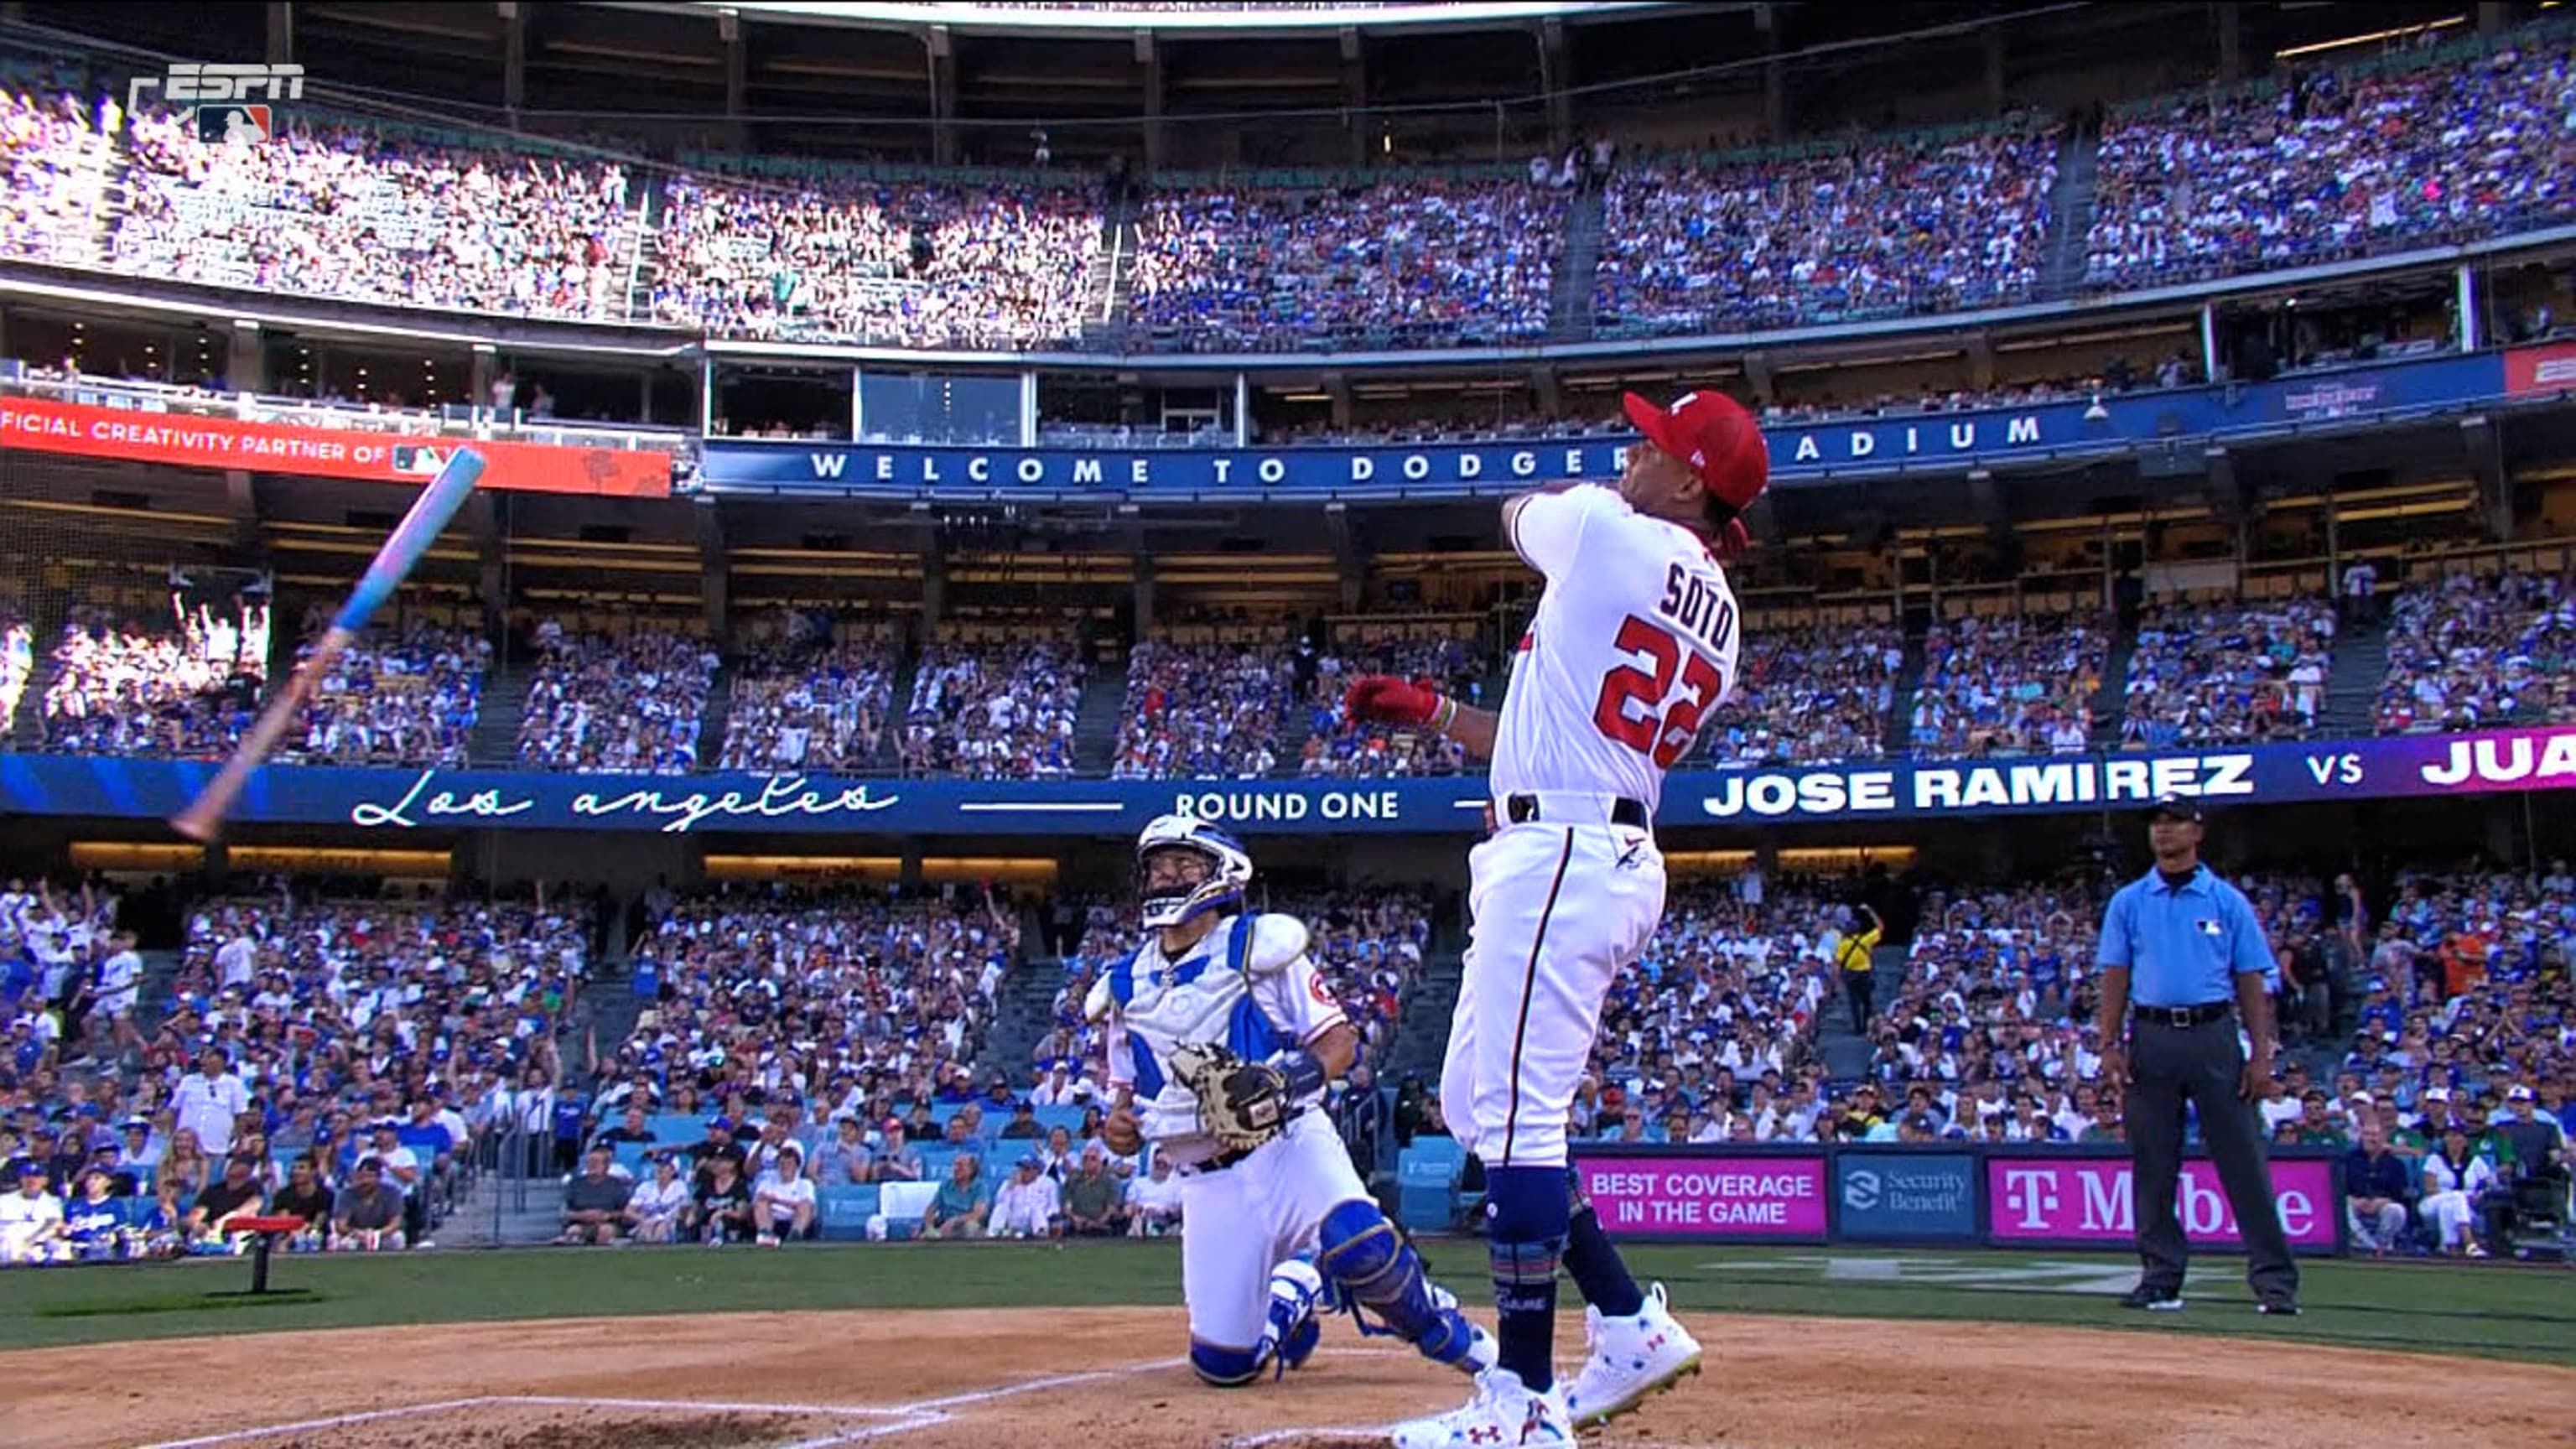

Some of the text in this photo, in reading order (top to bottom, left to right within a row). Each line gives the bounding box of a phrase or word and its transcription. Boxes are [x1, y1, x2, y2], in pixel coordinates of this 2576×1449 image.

[91, 421, 234, 451] CREATIVITY
[242, 435, 345, 460] PARTNER
[354, 445, 385, 463] OF
[812, 454, 1148, 483] WELCOME
[1213, 458, 1285, 483] TO
[1795, 417, 2040, 462] ADIUM
[1660, 563, 1733, 652] SOTO
[1594, 613, 1722, 770] 22
[352, 770, 533, 826] Los
[1176, 792, 1398, 820] ROUND ONE
[1703, 772, 1895, 817] JOSE
[1914, 755, 2254, 808] RAMIREZ
[1592, 1174, 1813, 1197] BEST COVERAGE
[1888, 1171, 1965, 1201] Security
[1889, 1191, 1957, 1213] Benefit
[1618, 1200, 1788, 1224] IN THE GAME
